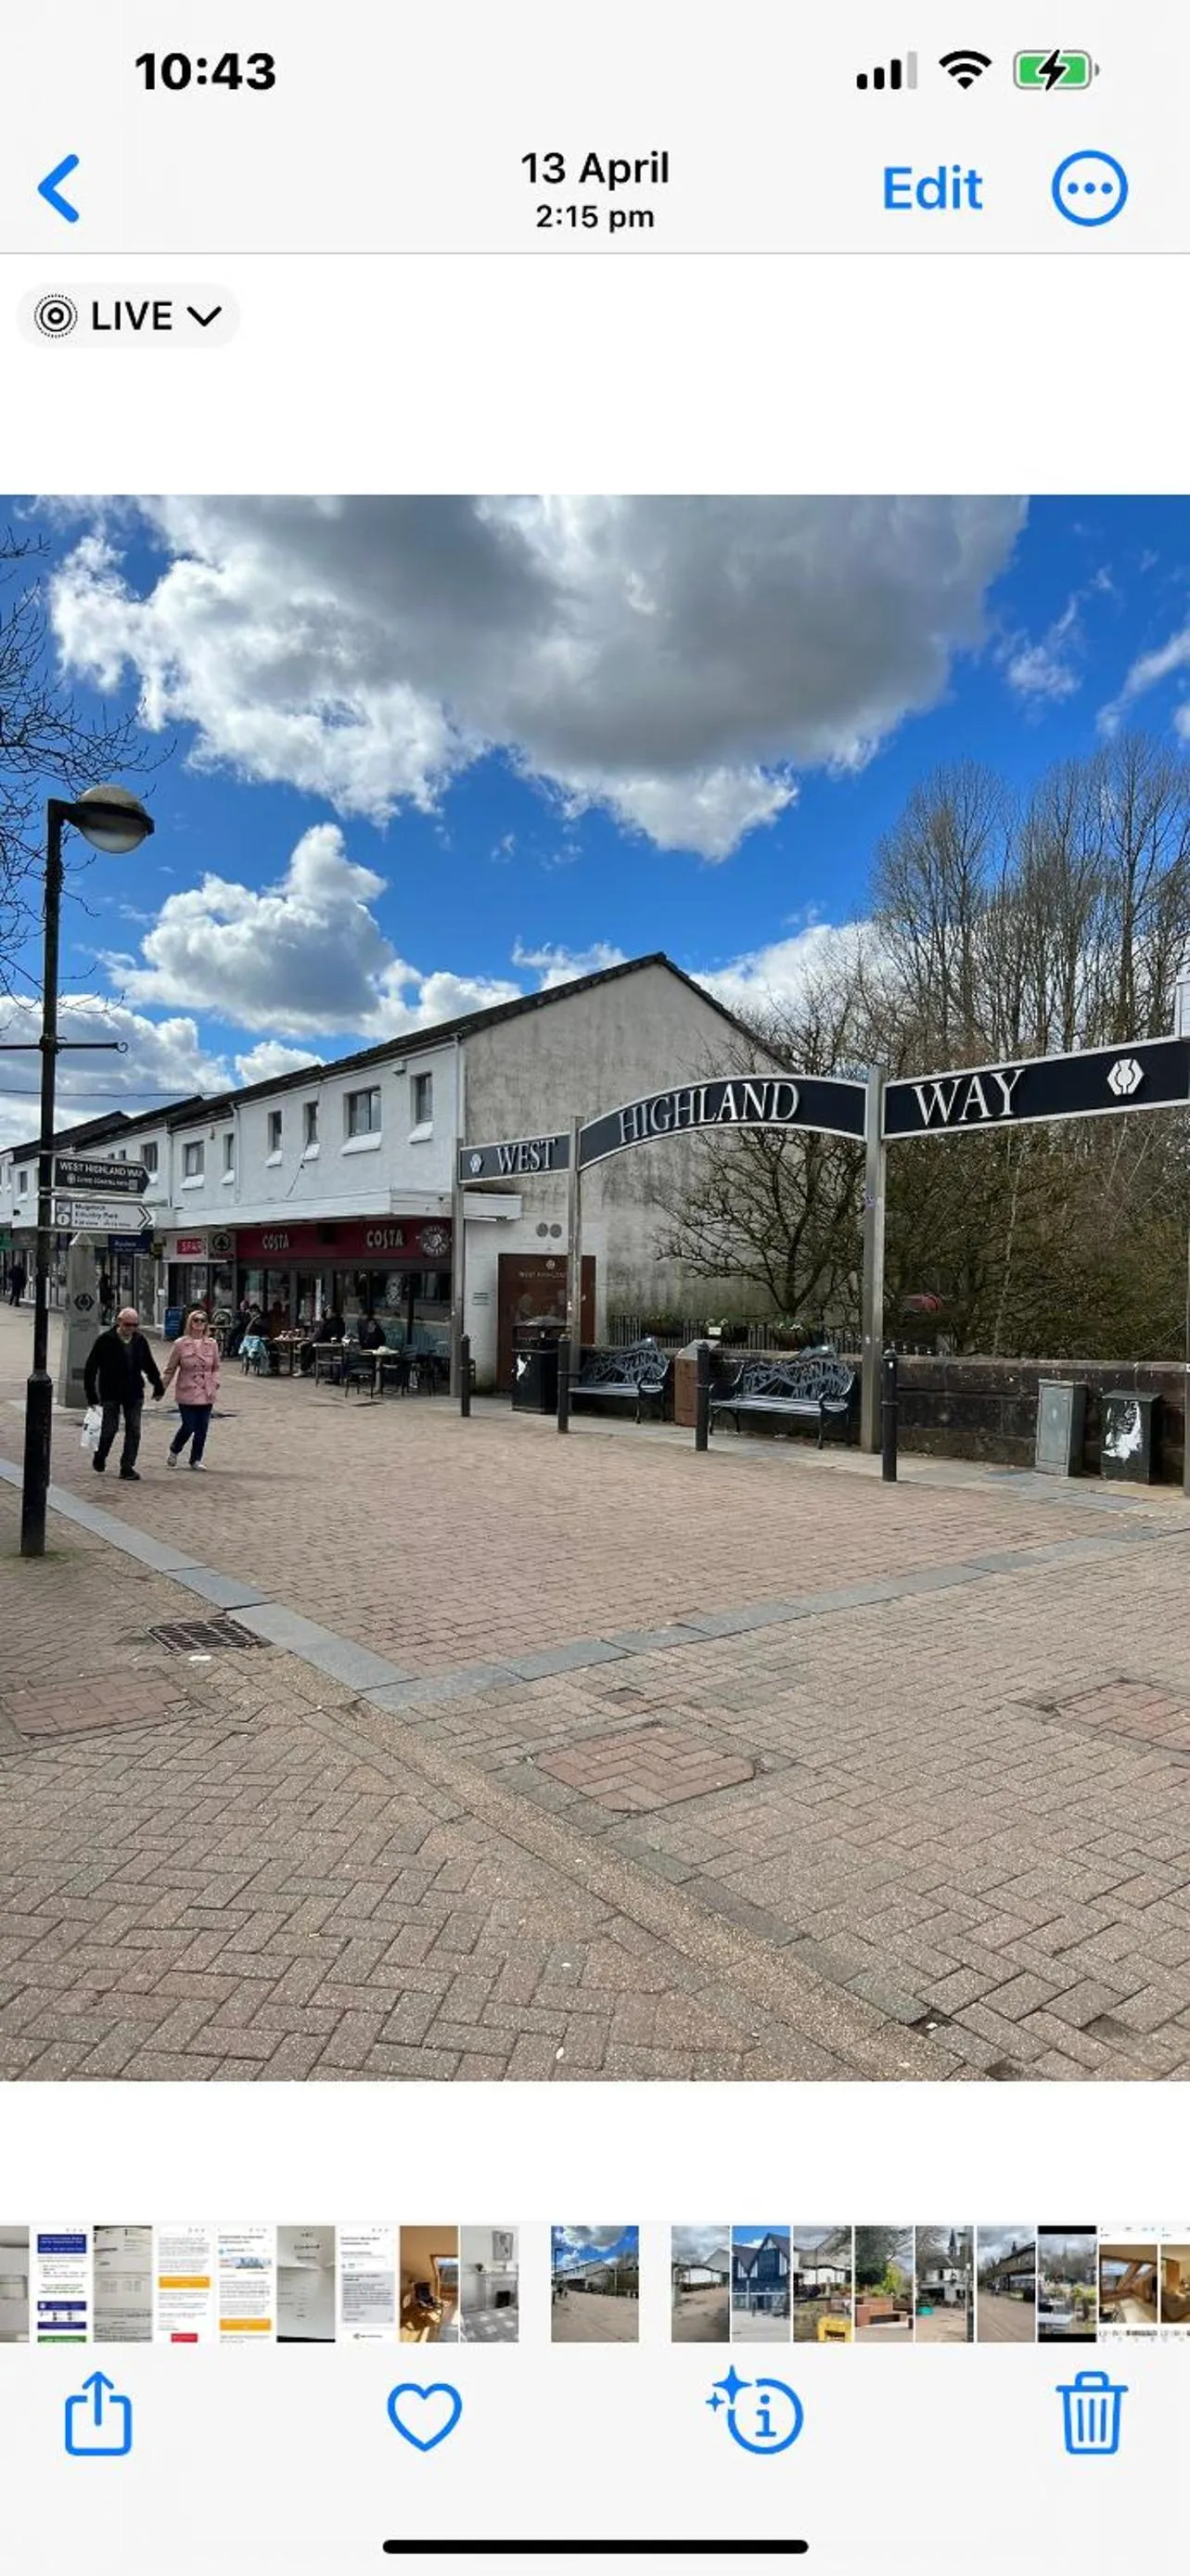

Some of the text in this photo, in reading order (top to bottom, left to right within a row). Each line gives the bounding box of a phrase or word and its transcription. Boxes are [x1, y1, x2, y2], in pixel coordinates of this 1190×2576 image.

[136, 53, 275, 91] 10:43
[521, 151, 669, 192] 13 April
[884, 166, 983, 210] Edit
[536, 204, 654, 234] 2:15 pm
[92, 300, 173, 331] LIVE
[495, 1068, 1026, 1174] WEST HIGHLAND WAY
[59, 1161, 83, 1171] WEST
[84, 1165, 126, 1177] HIGHLAND
[262, 1234, 290, 1250] COSTA
[366, 1229, 404, 1249] COSTA
